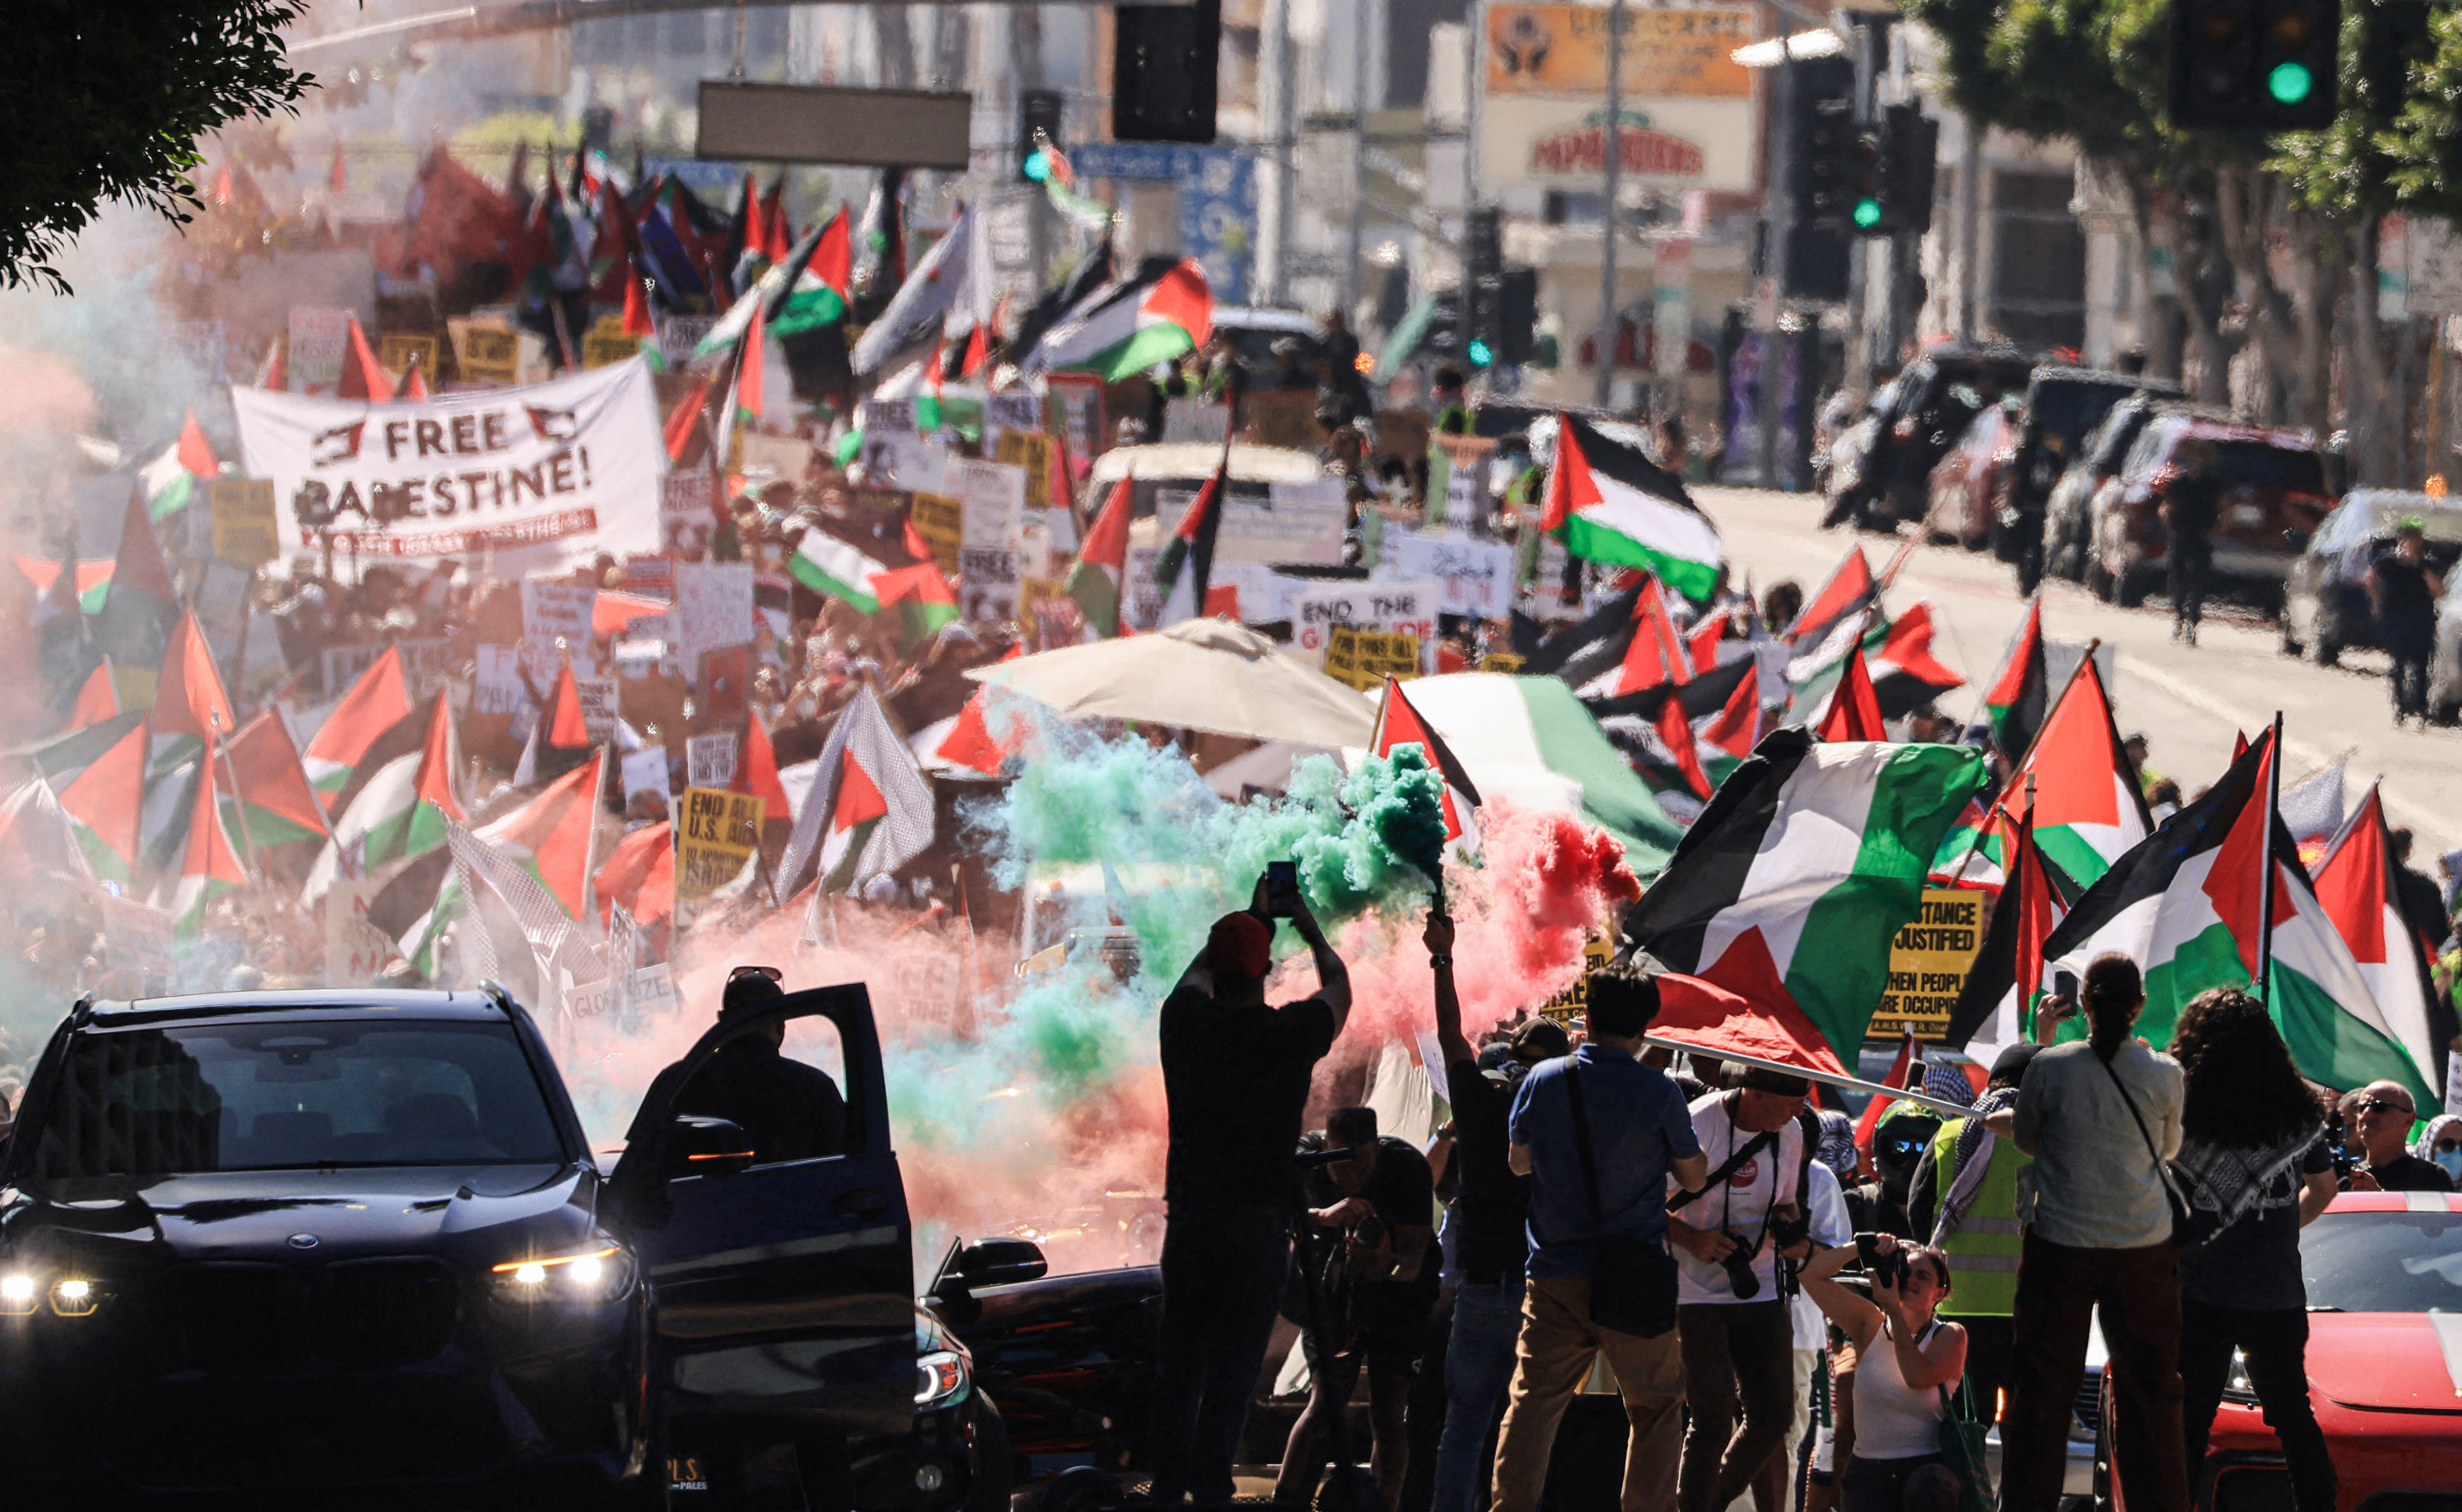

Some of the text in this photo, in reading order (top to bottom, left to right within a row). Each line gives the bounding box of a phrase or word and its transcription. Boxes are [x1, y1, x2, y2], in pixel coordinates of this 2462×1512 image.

[384, 412, 510, 459] FREE
[295, 446, 592, 524] PAESTINE!
[1301, 596, 1415, 623] END THE
[690, 792, 725, 818] END
[687, 815, 719, 843] U.S.
[1894, 928, 1975, 951] JUSTIFIED
[1886, 972, 1968, 993] HEN PEOPL
